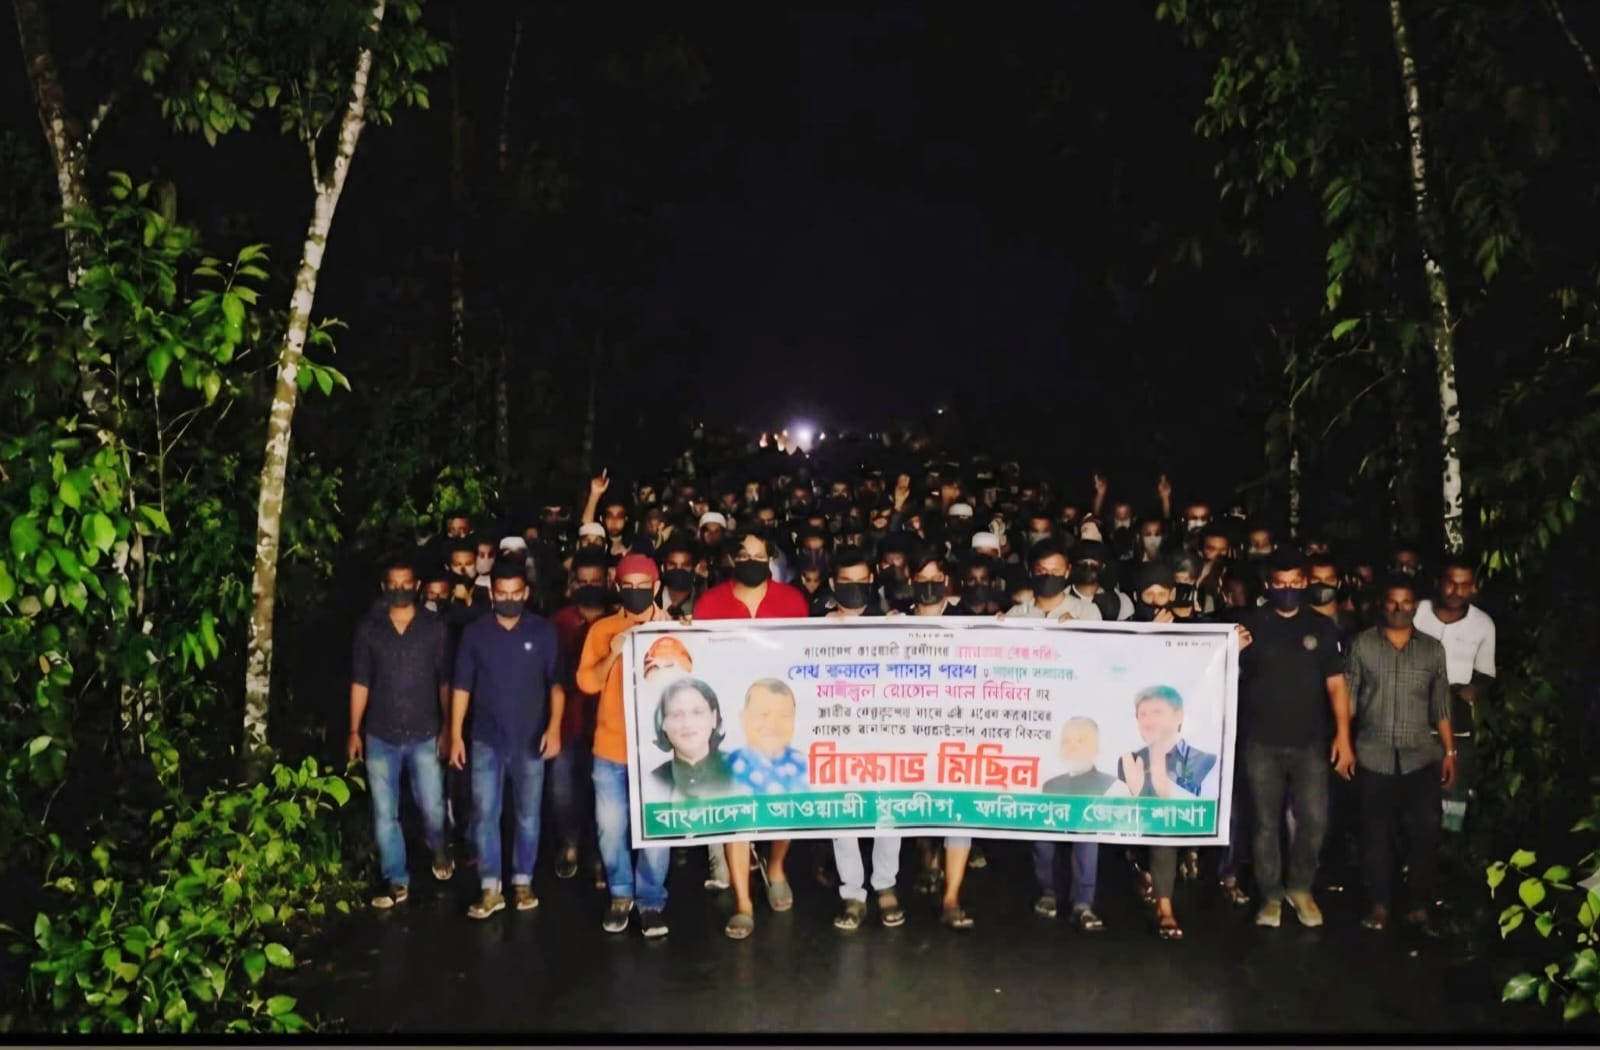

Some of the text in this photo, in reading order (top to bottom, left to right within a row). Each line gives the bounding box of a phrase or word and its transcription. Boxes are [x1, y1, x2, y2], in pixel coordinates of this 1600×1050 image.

[809, 741, 1041, 790] বিক্ষোভ মিছিল
[654, 792, 1207, 829] বাংলাদেশ আওয়ামী যুবলীগ, ফরিদপুর জেলা শাখা
